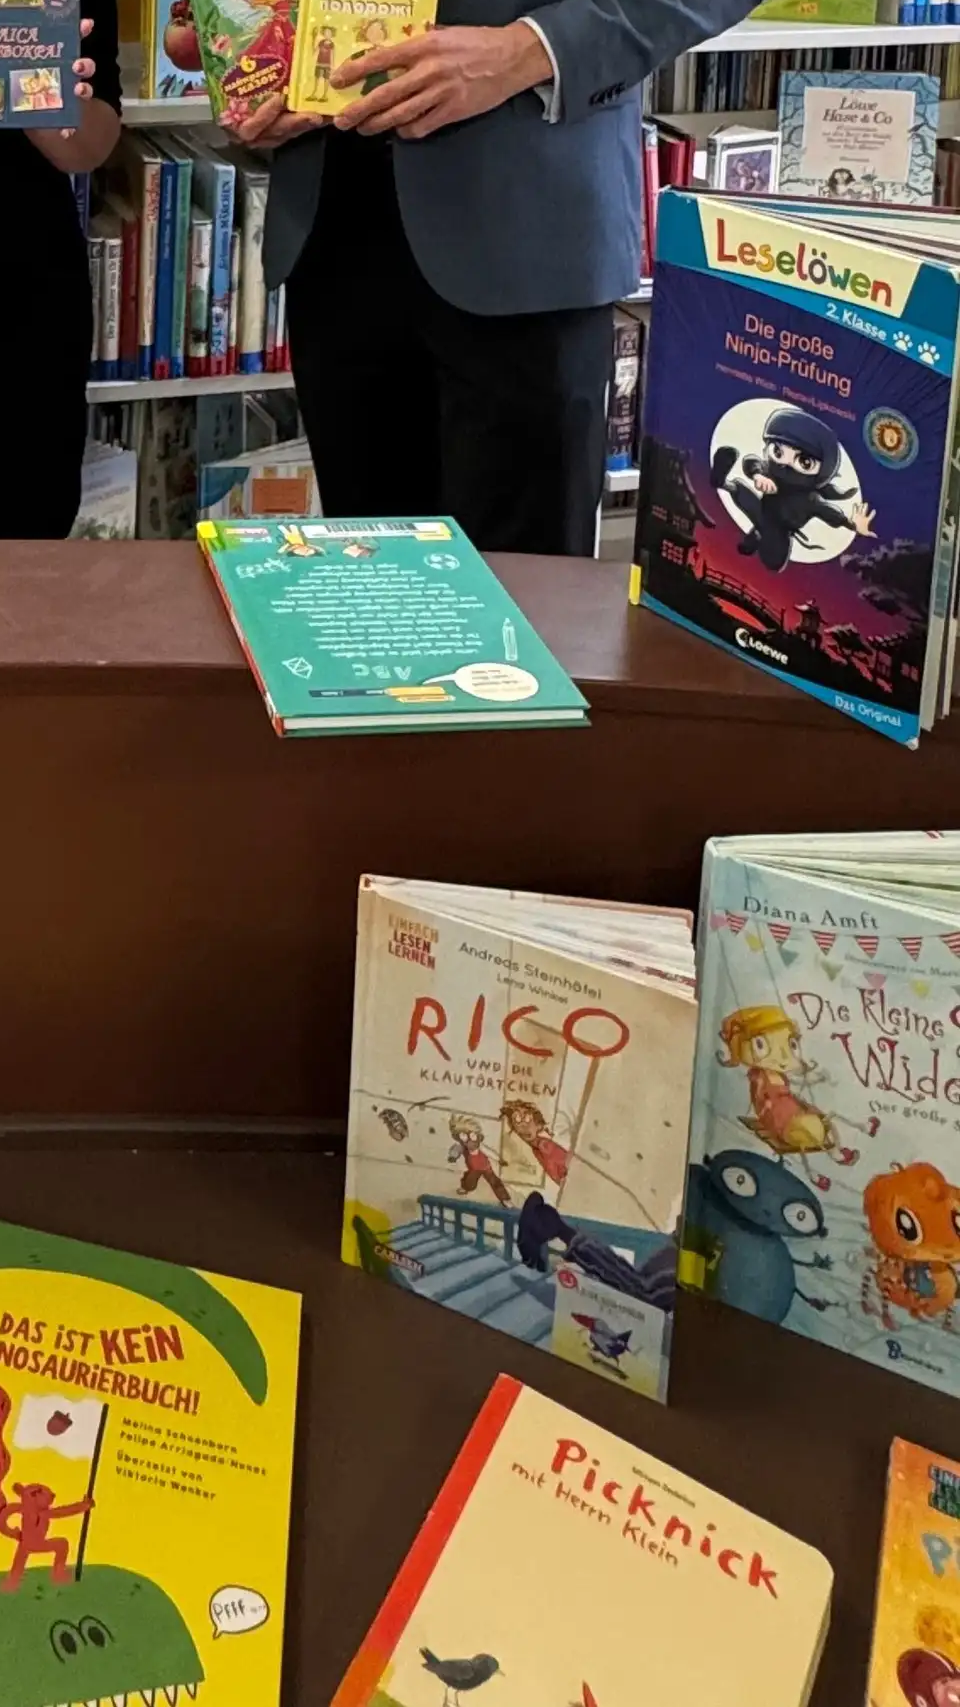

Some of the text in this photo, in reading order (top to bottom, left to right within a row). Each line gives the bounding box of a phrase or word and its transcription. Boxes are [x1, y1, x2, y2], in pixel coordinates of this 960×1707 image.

[822, 109, 893, 124] Hase & Co
[839, 96, 878, 111] Löwe
[716, 218, 892, 307] Leselöwen
[744, 314, 835, 360] Die große
[826, 303, 888, 341] 2. Klasse
[725, 332, 852, 398] Ninja-Prüfung
[835, 695, 901, 727] Das Original
[742, 895, 880, 930] Diana Amft
[388, 914, 439, 944] EINFACH
[393, 930, 432, 953] LESEN
[388, 941, 436, 971] LERNEN
[458, 942, 602, 1001] Andreas Steinhöfel
[496, 973, 525, 991] Lena
[787, 992, 851, 1030] Die
[407, 994, 630, 1062] RICO
[420, 1068, 558, 1097] KLAUTÖRTCHEN
[466, 1057, 534, 1078] UND DIE
[903, 1105, 948, 1127] große
[119, 1431, 157, 1450] Felipe
[116, 1450, 204, 1483] Übersetzt von
[511, 1462, 679, 1568] mit Herrn Klein
[550, 1438, 778, 1600] Picknick
